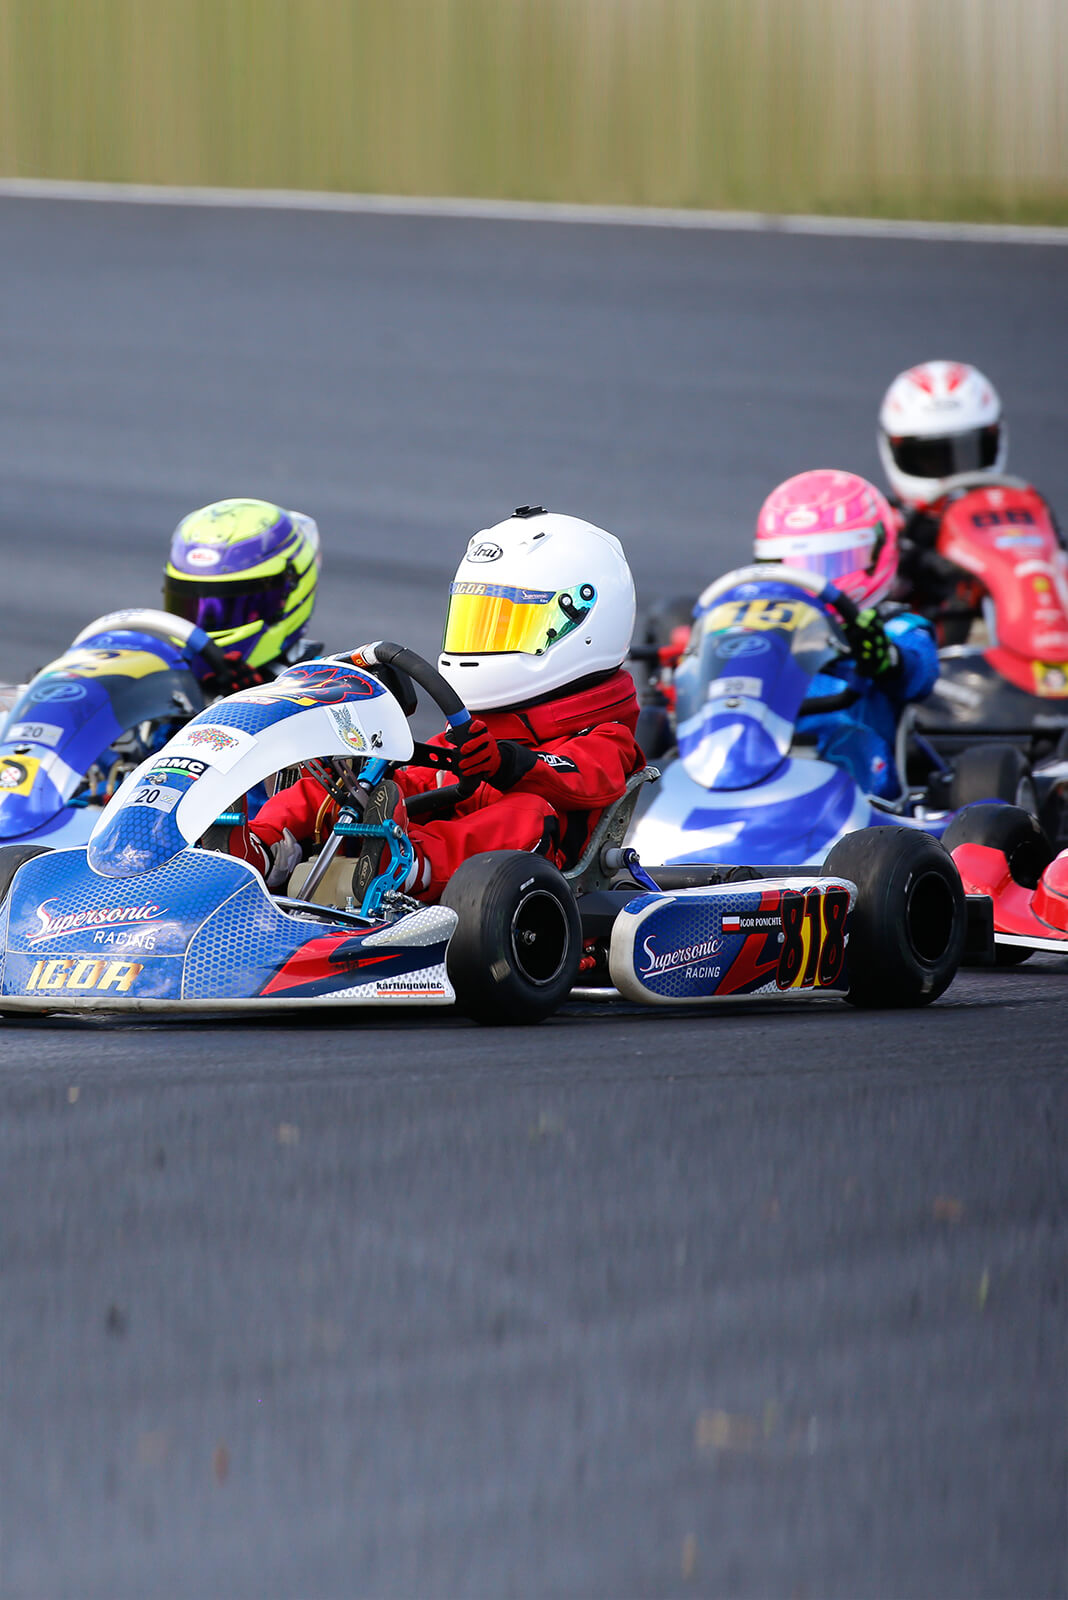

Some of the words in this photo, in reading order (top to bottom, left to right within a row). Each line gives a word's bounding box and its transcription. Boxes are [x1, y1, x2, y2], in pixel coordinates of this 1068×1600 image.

[20, 726, 43, 738] 20
[153, 759, 205, 773] RMC
[134, 789, 160, 804] 20
[26, 897, 170, 946] Supersonic
[740, 918, 755, 928] IGOR
[93, 931, 156, 950] RACING
[776, 886, 850, 990] 818
[639, 934, 724, 979] Supersonic
[26, 959, 144, 991] IGOR
[685, 966, 721, 979] RACING
